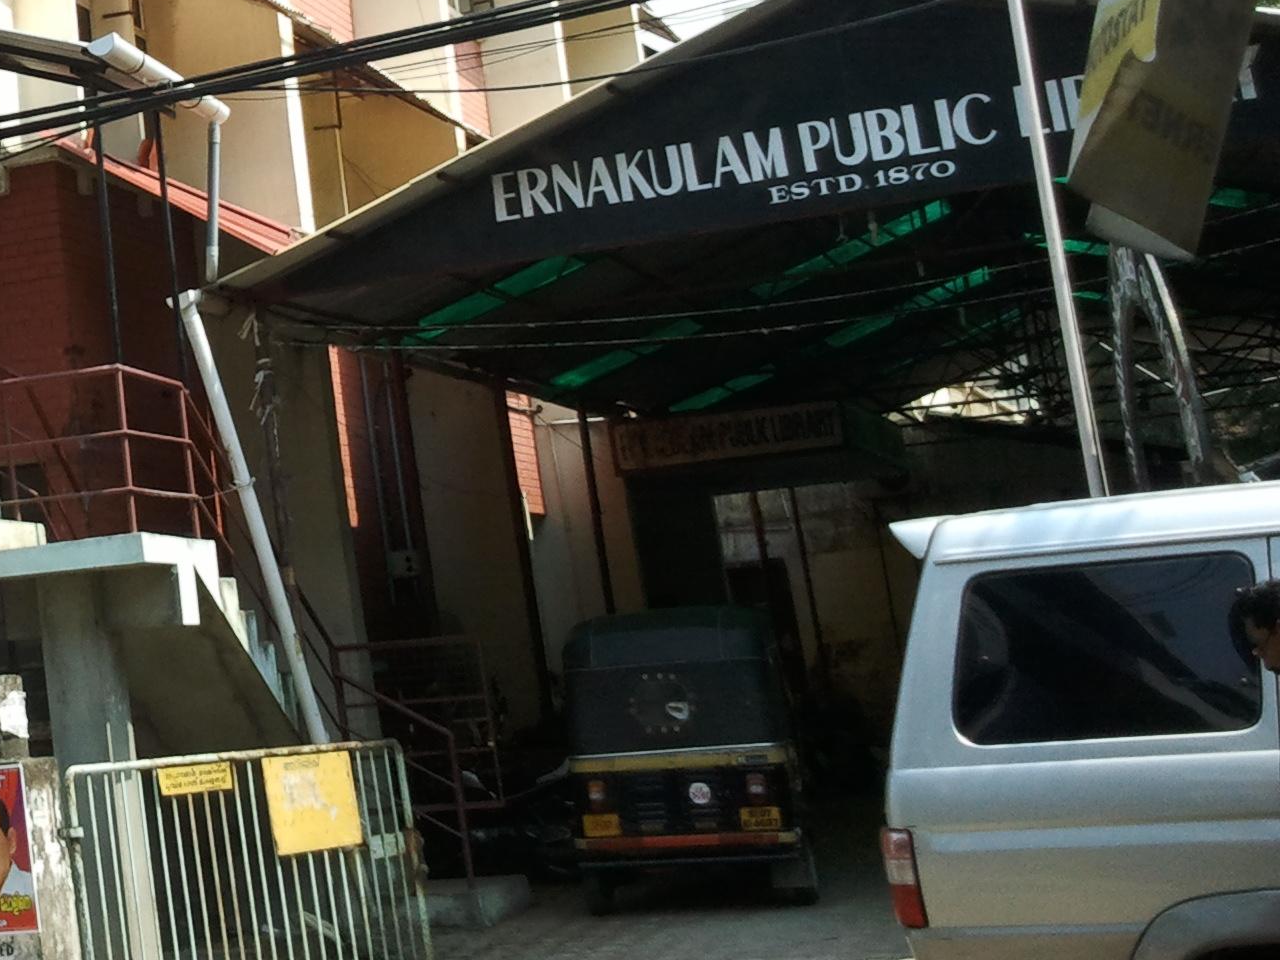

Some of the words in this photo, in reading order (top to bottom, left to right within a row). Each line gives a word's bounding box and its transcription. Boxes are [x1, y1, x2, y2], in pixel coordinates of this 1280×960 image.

[491, 125, 785, 222] ERNAKULAM
[796, 92, 997, 170] PUBLIC
[873, 159, 957, 190] 1870
